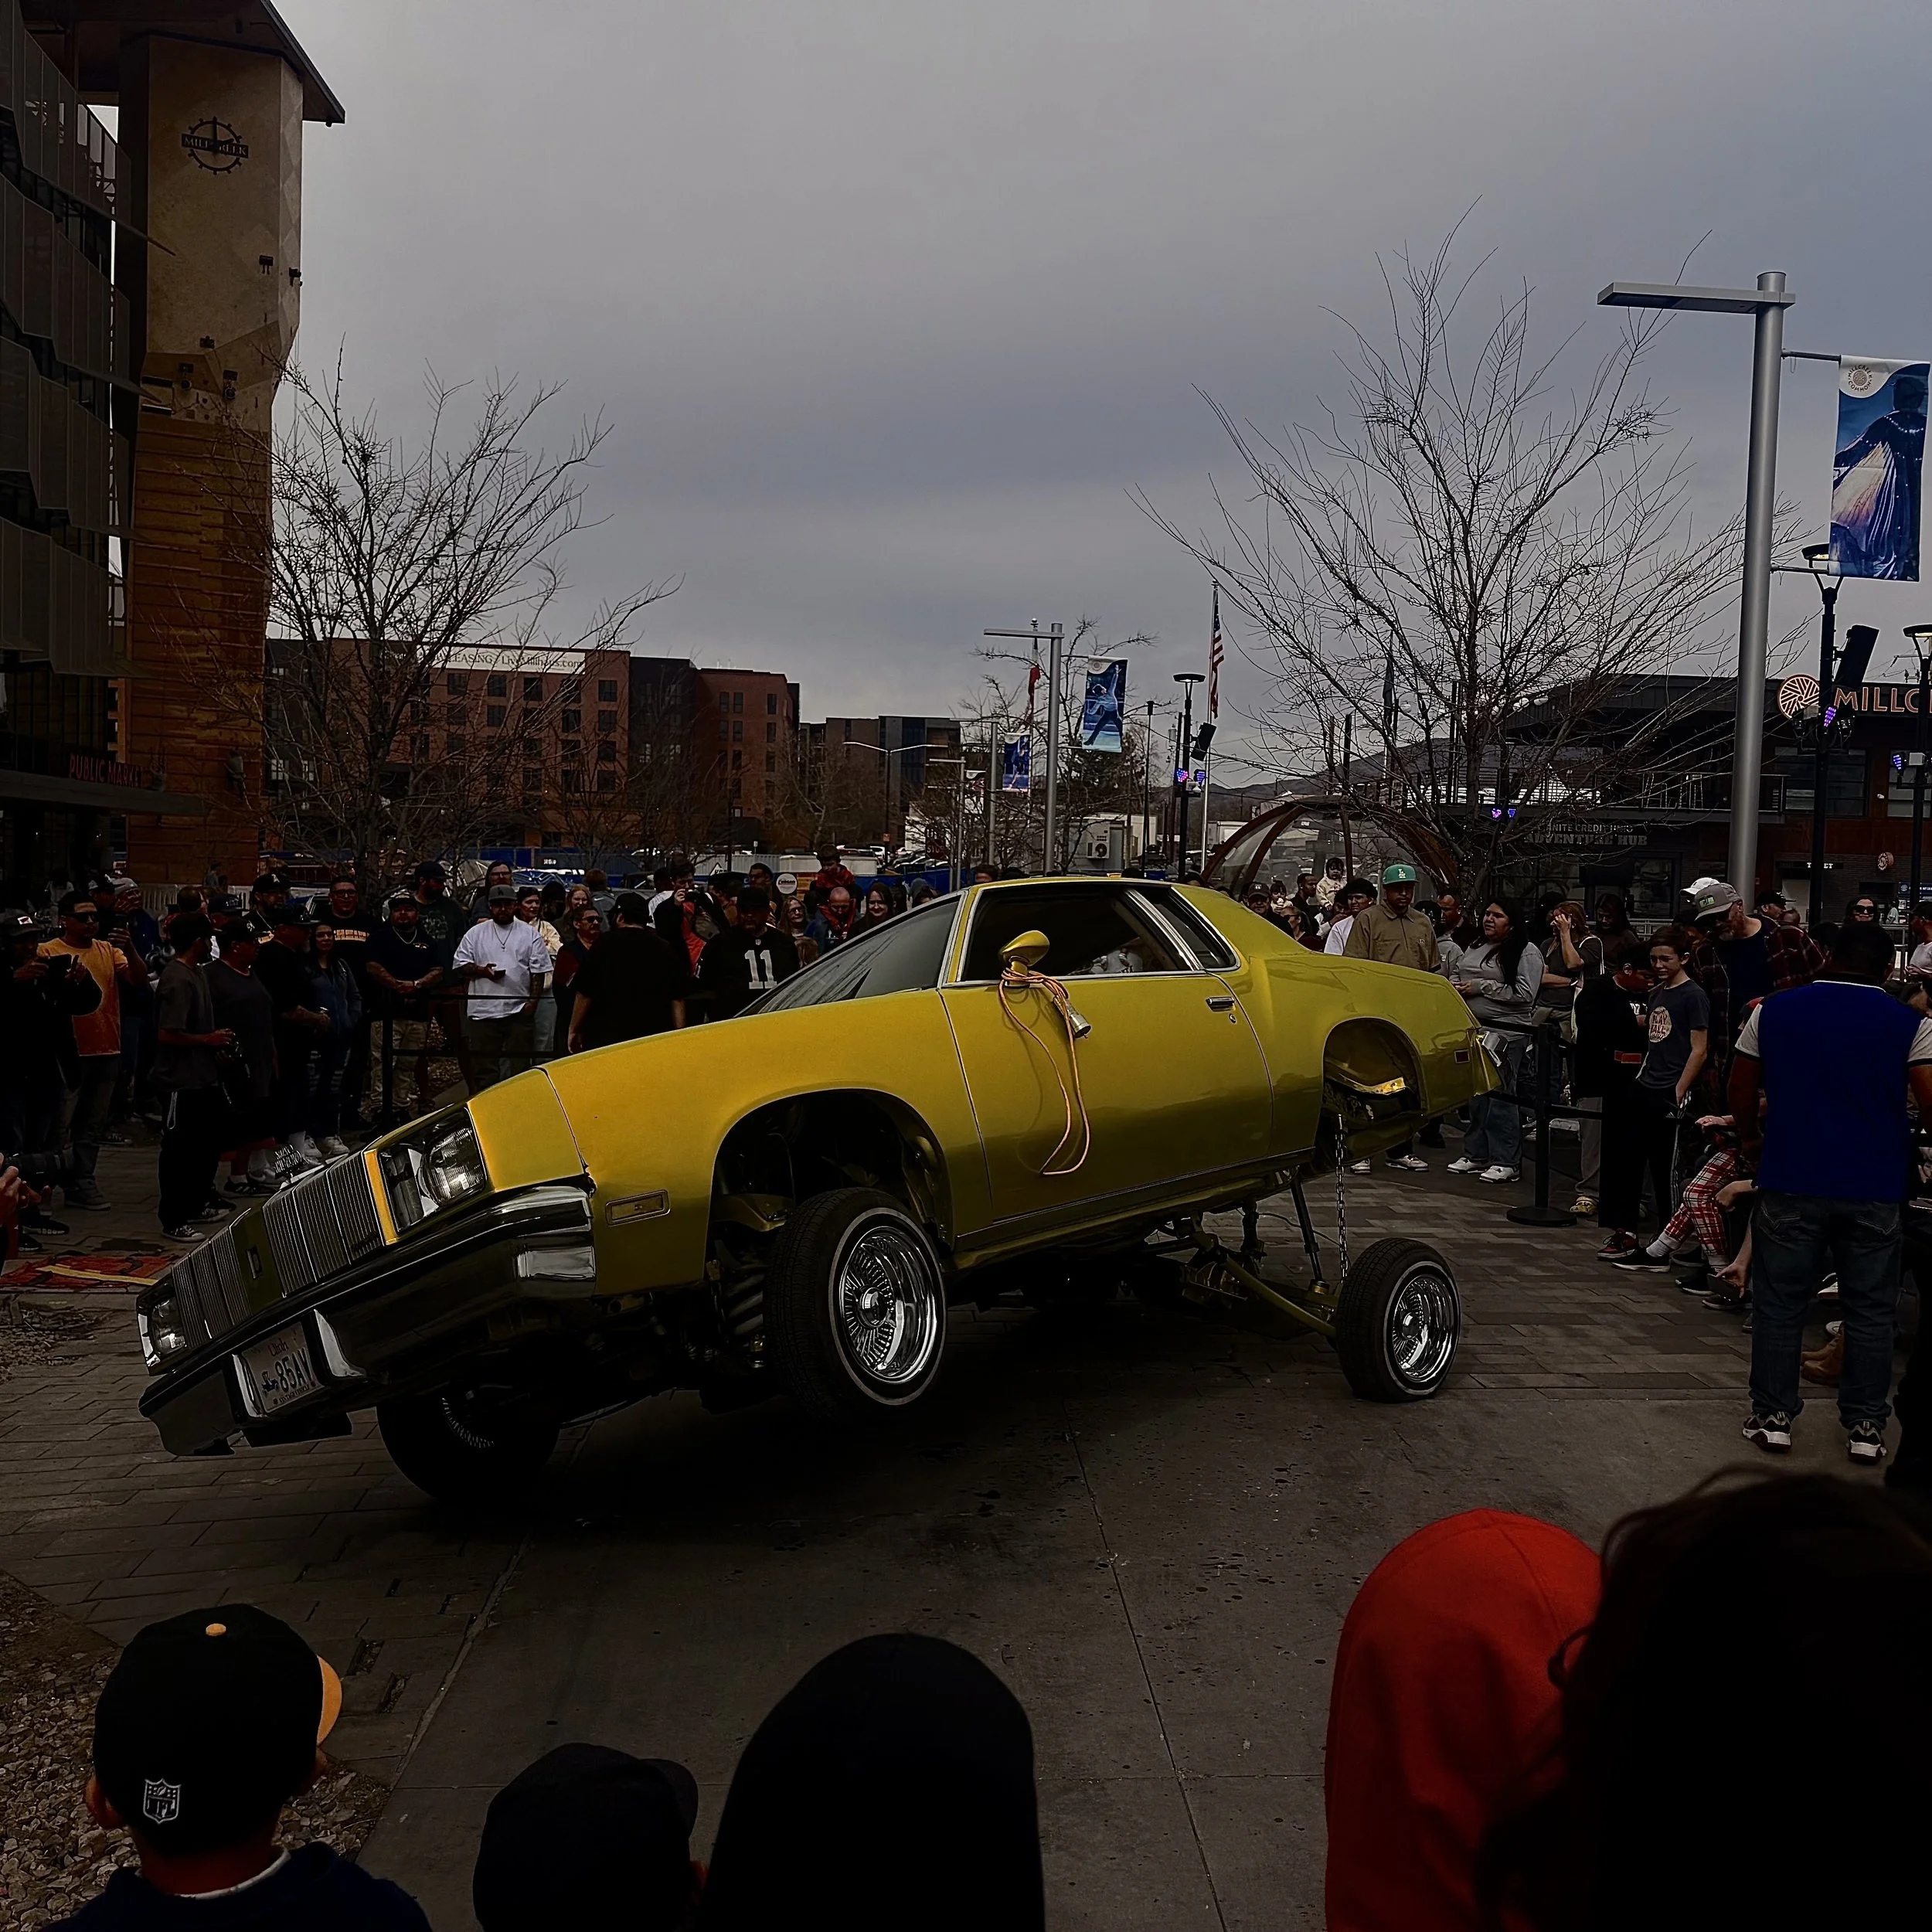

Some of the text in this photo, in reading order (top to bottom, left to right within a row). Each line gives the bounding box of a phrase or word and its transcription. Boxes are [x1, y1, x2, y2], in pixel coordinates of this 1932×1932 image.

[1848, 365, 1872, 378] MILLCREEK
[1848, 380, 1871, 392] COMMON
[69, 751, 106, 783] PUBLIC
[1524, 833, 1648, 846] ADVENTURE HUB
[744, 949, 778, 991] 11
[267, 1338, 289, 1356] Utah
[274, 1347, 312, 1393] 85AV
